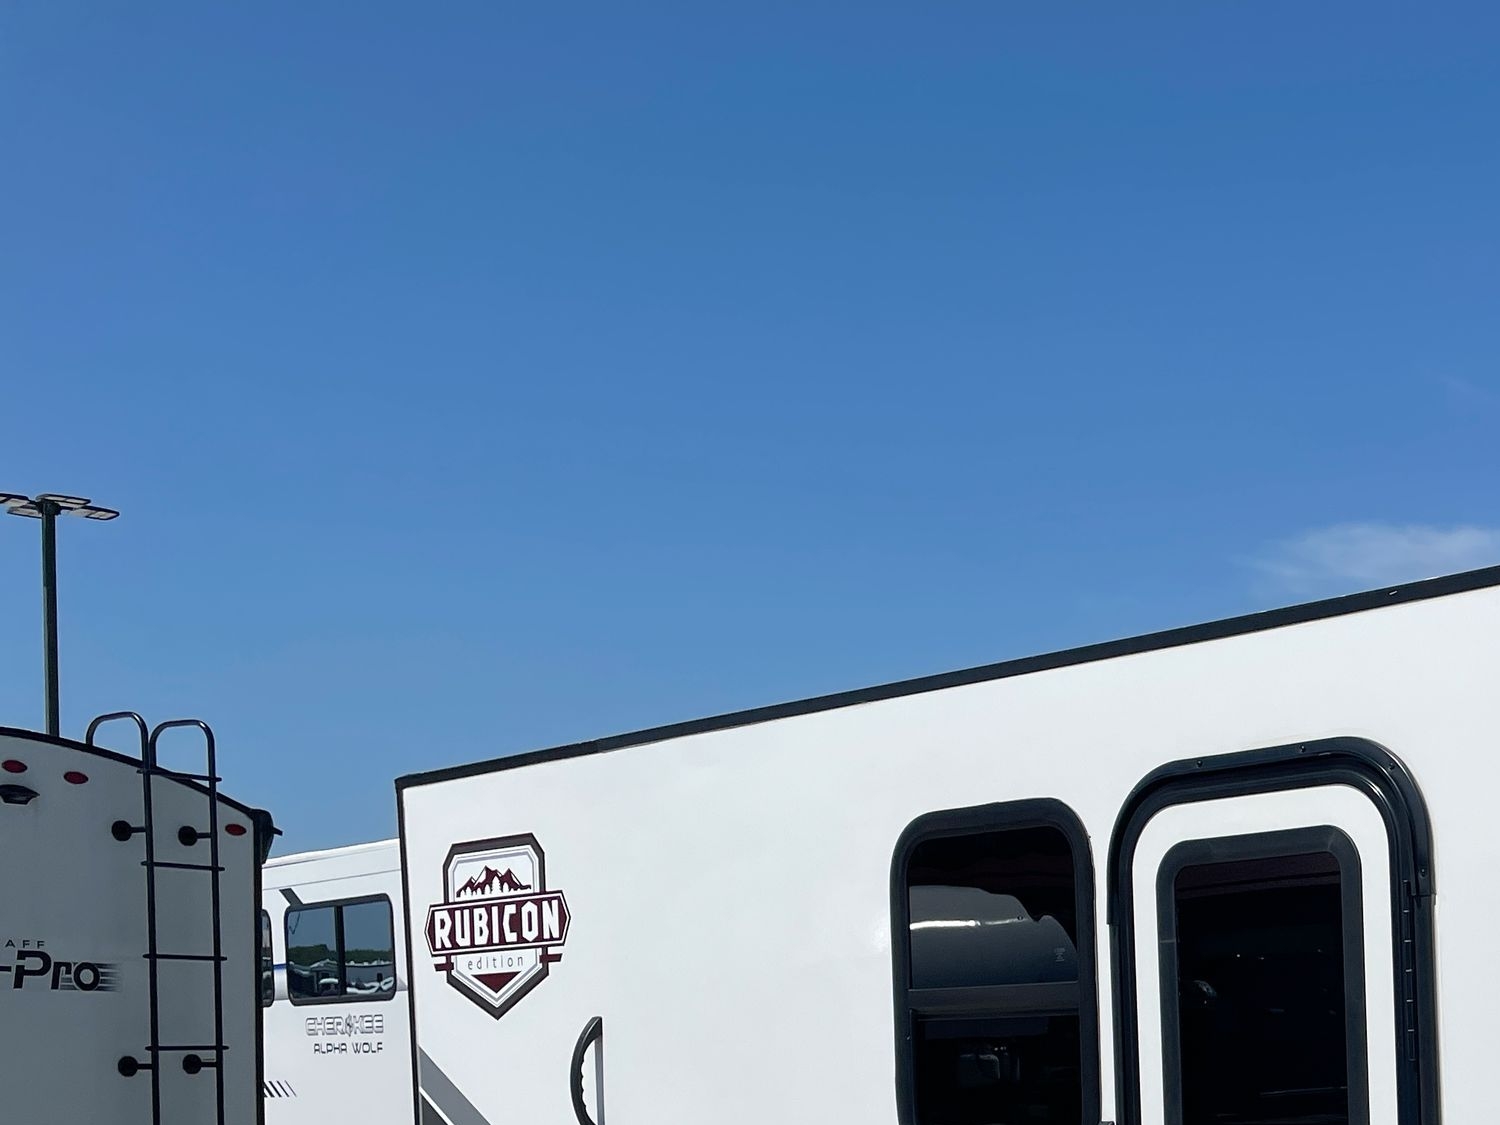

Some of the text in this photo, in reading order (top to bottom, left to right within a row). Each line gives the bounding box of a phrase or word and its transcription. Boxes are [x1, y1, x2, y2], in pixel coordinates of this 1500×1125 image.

[434, 899, 560, 949] RUBICON
[467, 956, 523, 970] edition
[313, 1042, 383, 1054] ALPHA WOLF
